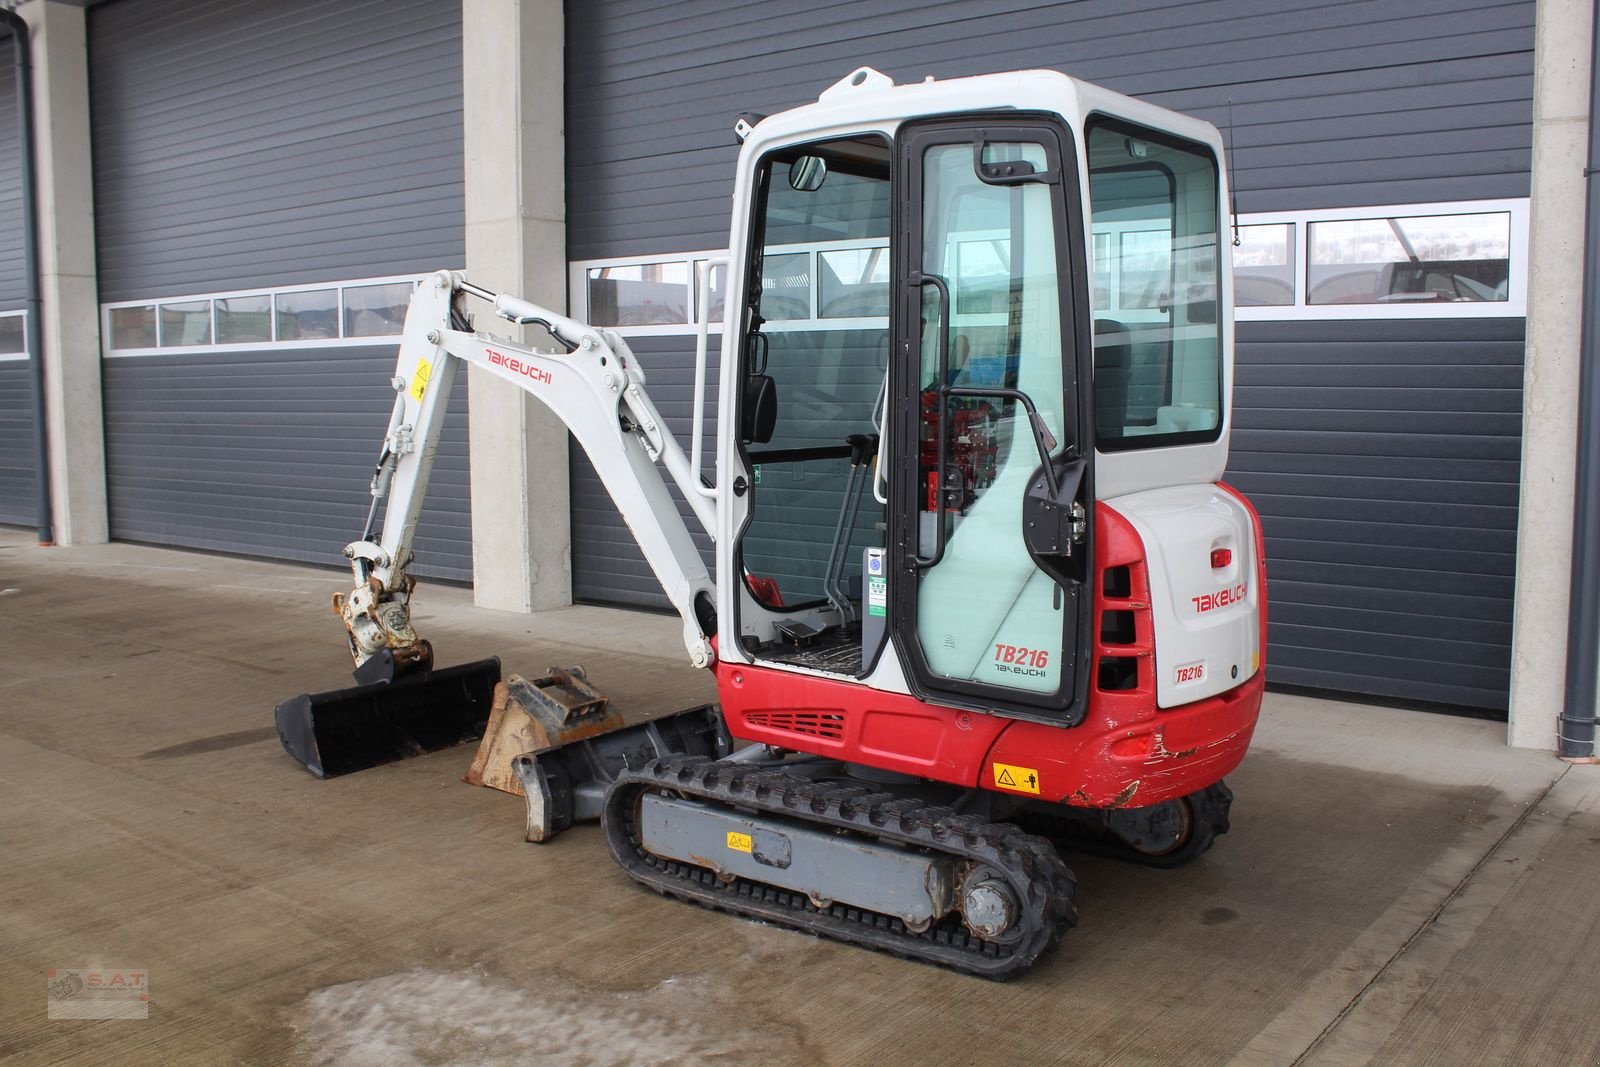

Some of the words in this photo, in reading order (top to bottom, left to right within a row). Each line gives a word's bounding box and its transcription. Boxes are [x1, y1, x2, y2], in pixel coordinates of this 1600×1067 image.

[485, 348, 552, 385] TAKEUCHI
[995, 643, 1049, 669] TB216
[1176, 664, 1203, 683] TB216
